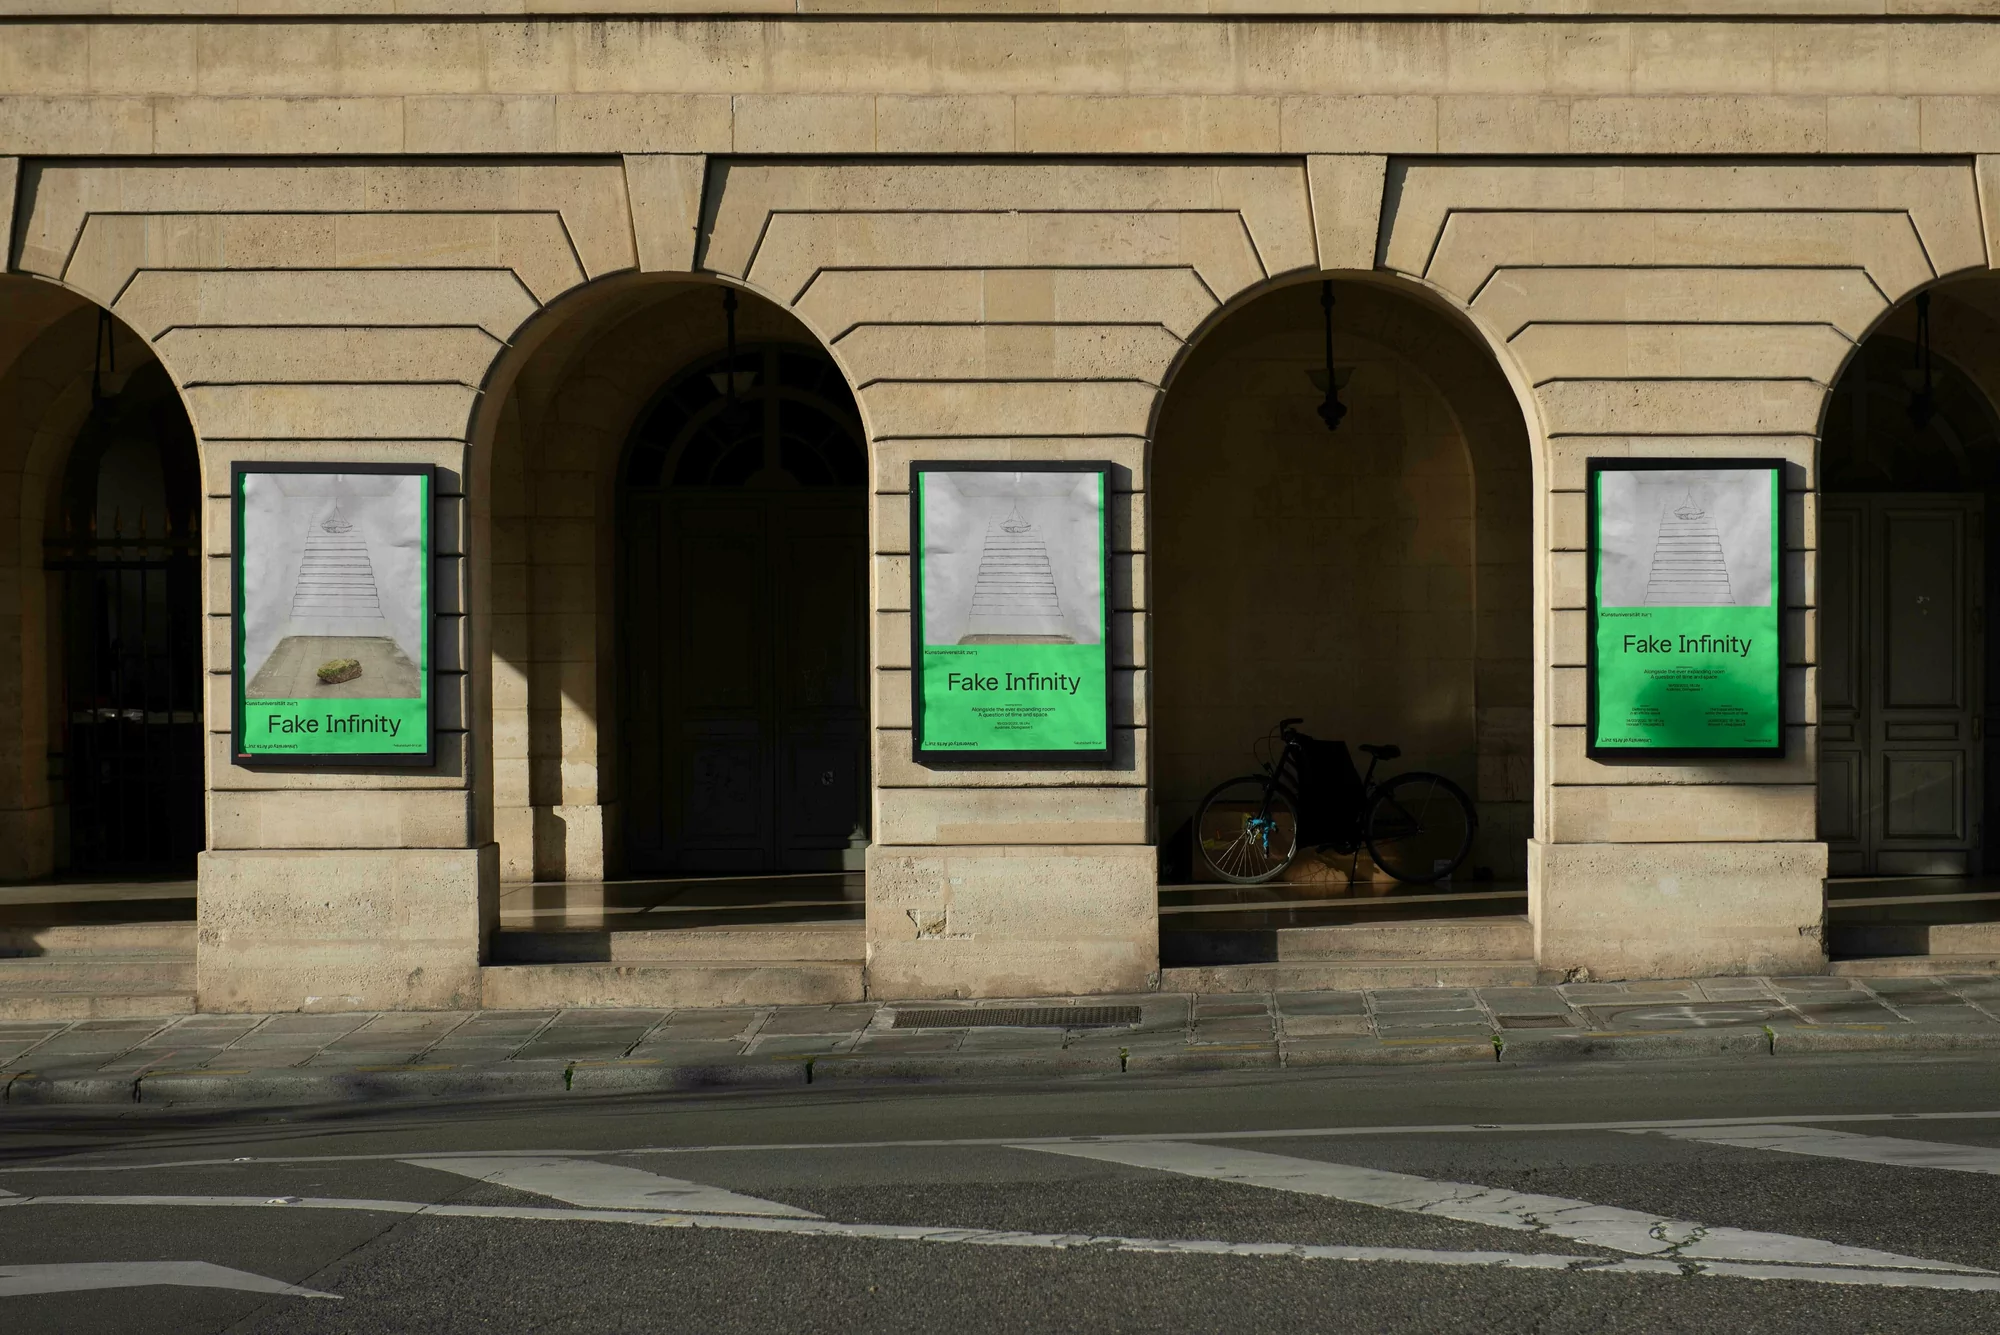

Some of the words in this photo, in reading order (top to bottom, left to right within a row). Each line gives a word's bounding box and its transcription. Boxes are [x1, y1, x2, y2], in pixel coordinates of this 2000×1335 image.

[1624, 634, 1672, 653] Fake
[1678, 634, 1752, 658] Infinity
[948, 672, 998, 691] Fake
[1006, 672, 1081, 695] Infinity
[268, 714, 318, 734] Fake
[326, 714, 402, 738] Infinity
